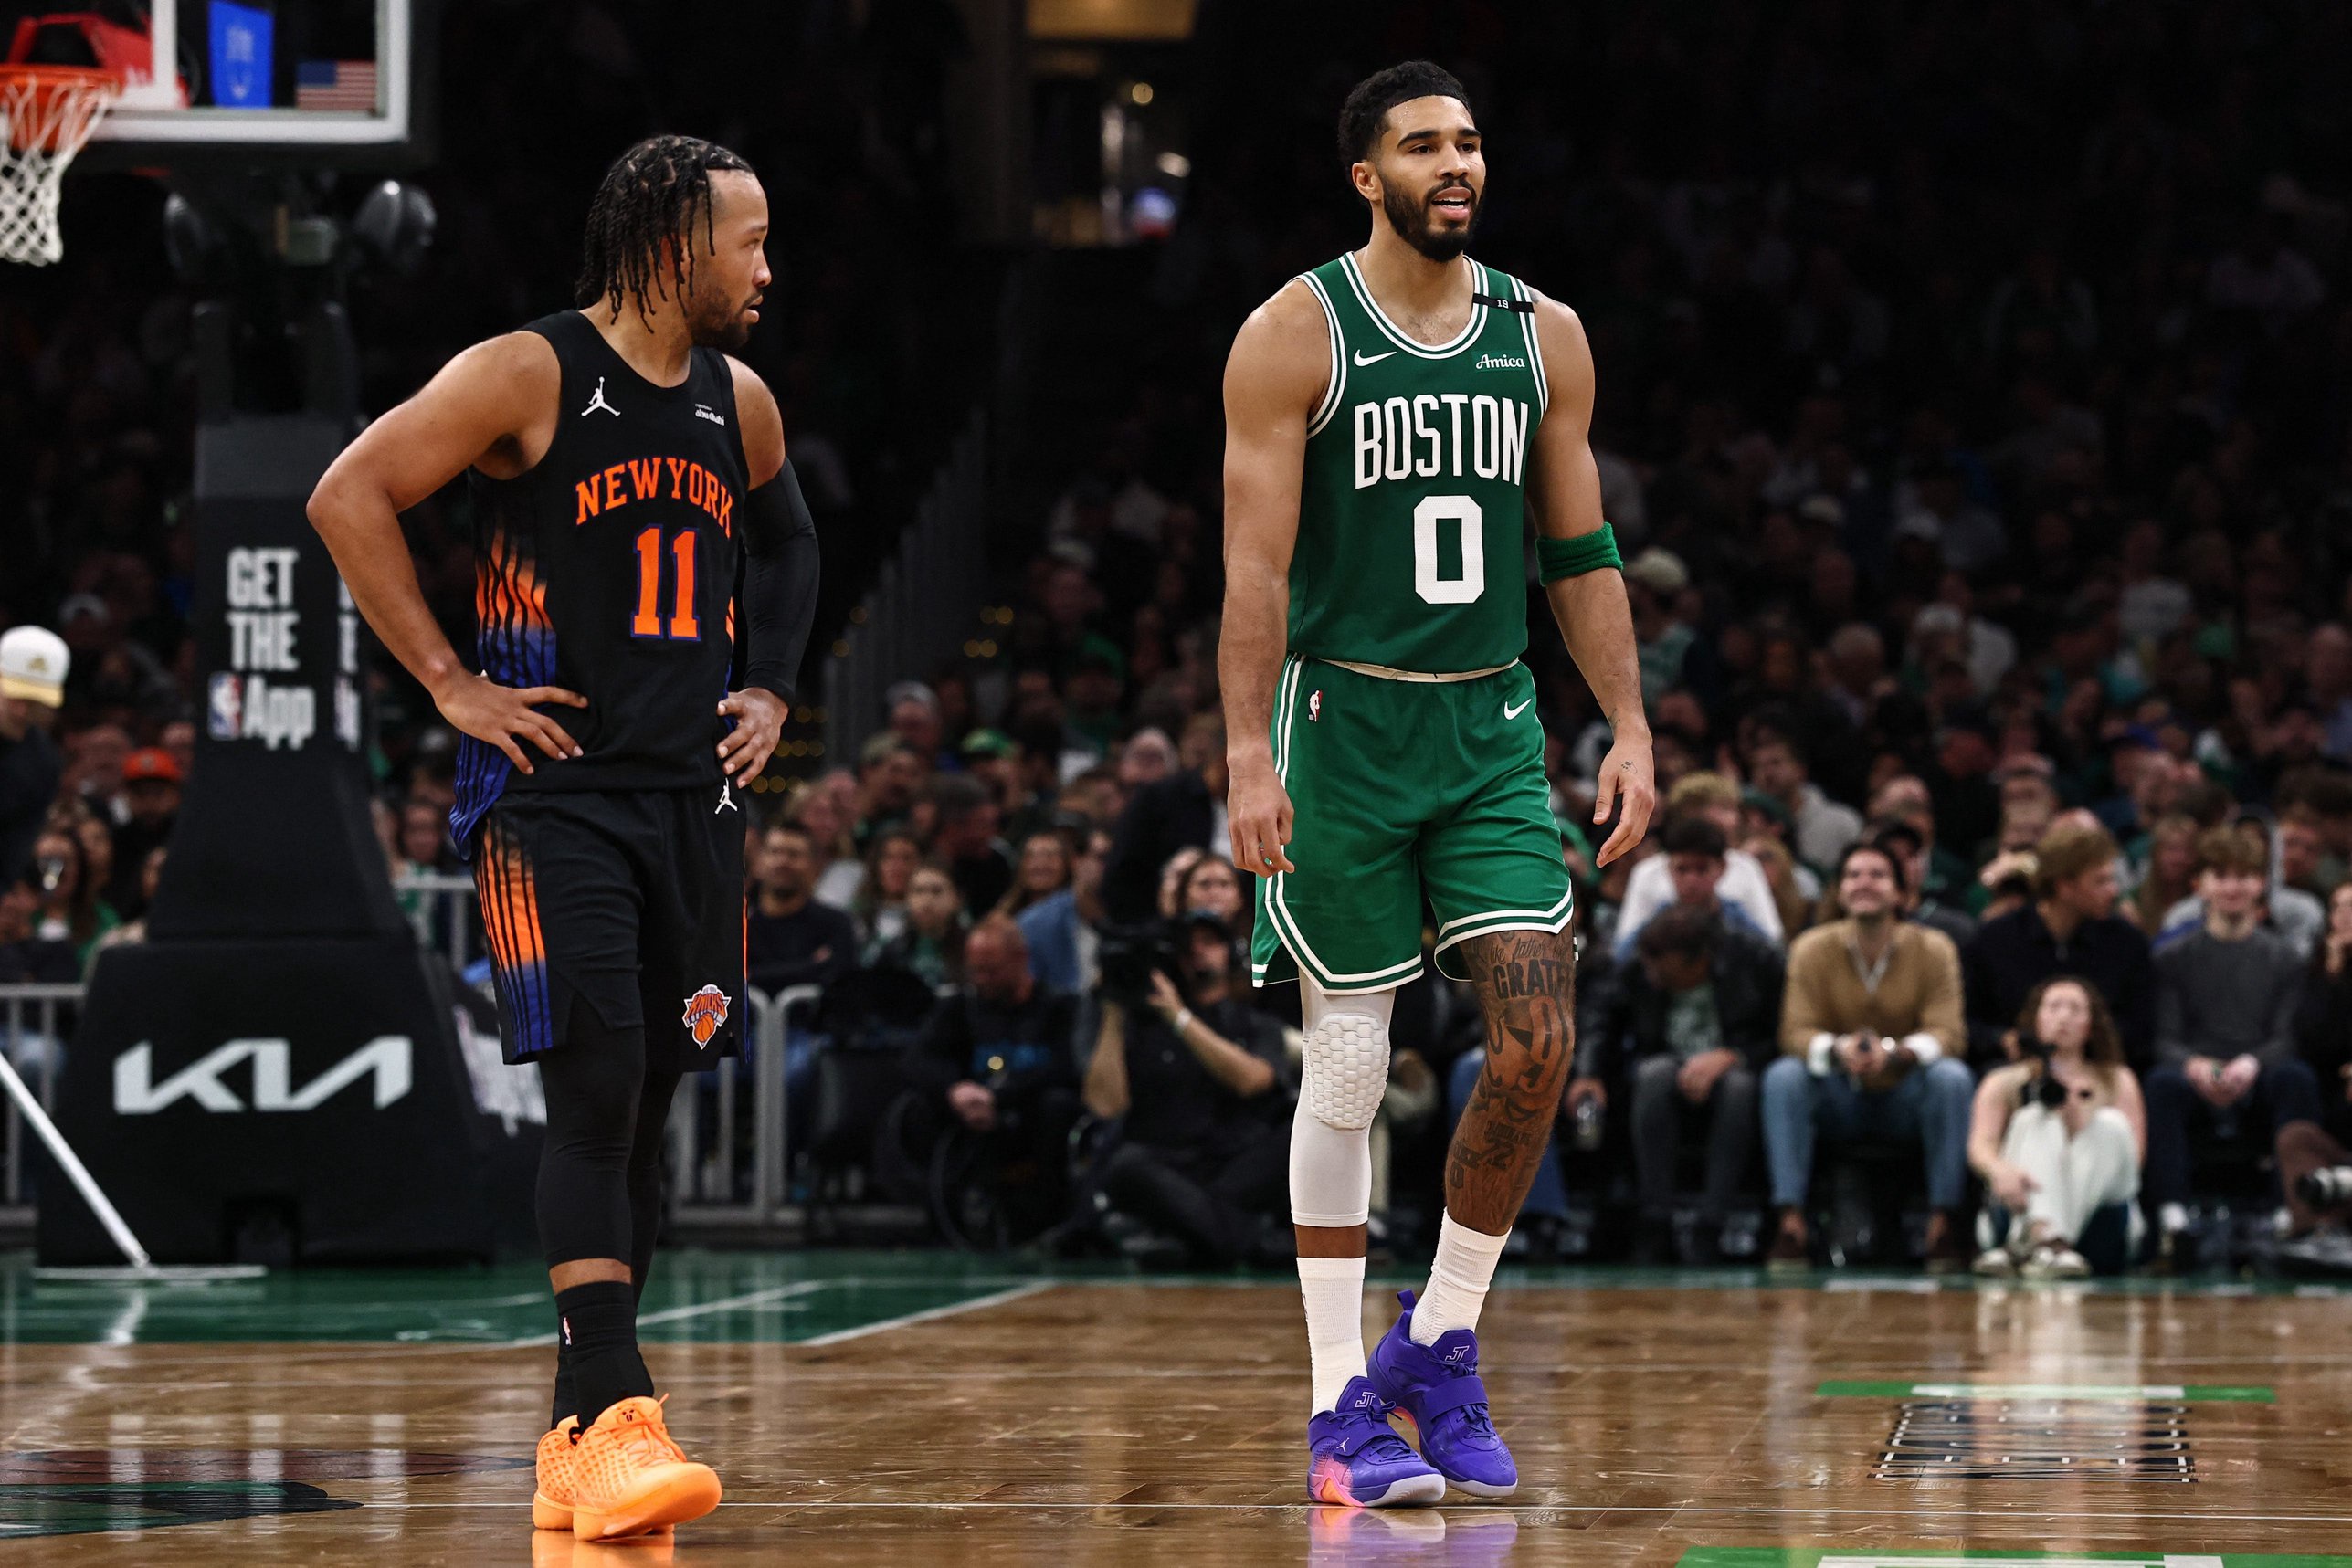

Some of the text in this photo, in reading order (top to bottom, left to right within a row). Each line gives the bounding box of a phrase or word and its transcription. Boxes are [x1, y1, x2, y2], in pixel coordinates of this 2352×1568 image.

[1497, 300, 1509, 309] 19
[1475, 353, 1525, 369] Amica
[1355, 394, 1528, 489] BOSTON
[575, 458, 733, 539] NEW YORK
[227, 547, 300, 608] GET
[631, 523, 701, 641] 11
[1414, 495, 1485, 605] 0
[226, 611, 300, 671] THE
[241, 673, 316, 751] App
[114, 1036, 413, 1114] KIA
